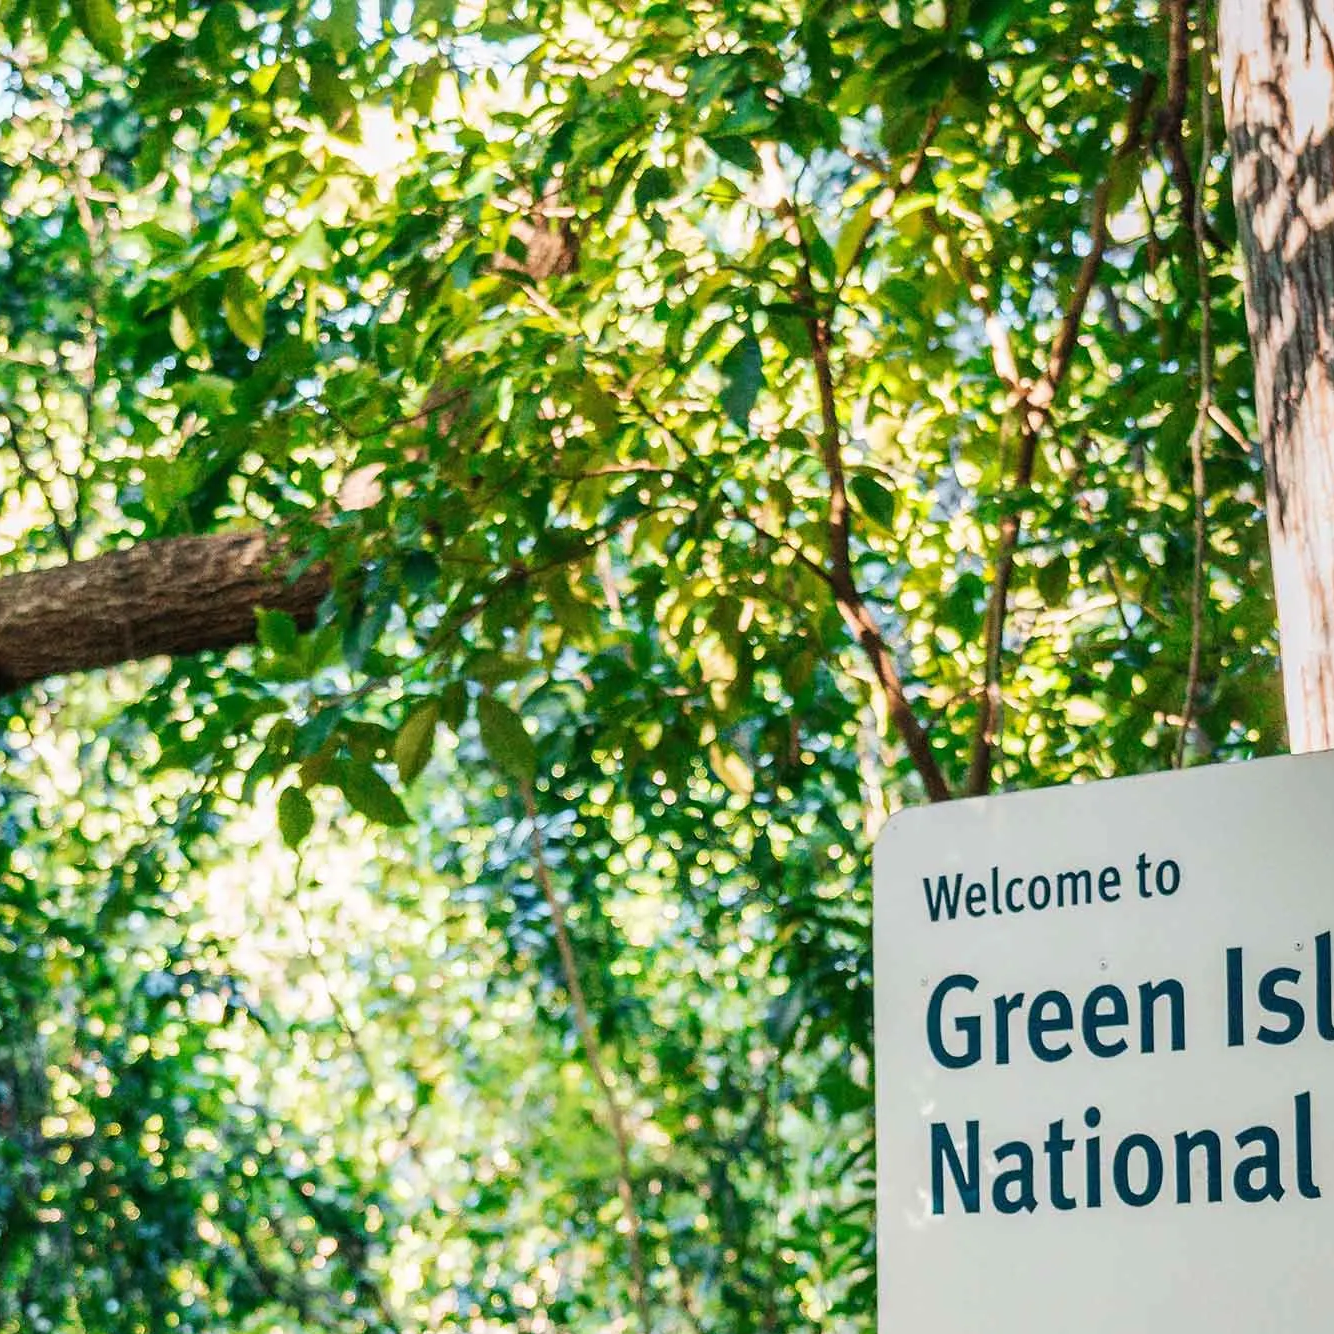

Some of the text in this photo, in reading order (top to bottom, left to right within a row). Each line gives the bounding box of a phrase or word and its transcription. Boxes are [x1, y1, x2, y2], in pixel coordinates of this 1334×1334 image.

[922, 852, 1181, 922] Welcome to
[926, 974, 1186, 1069] Green
[930, 1090, 1322, 1215] National
